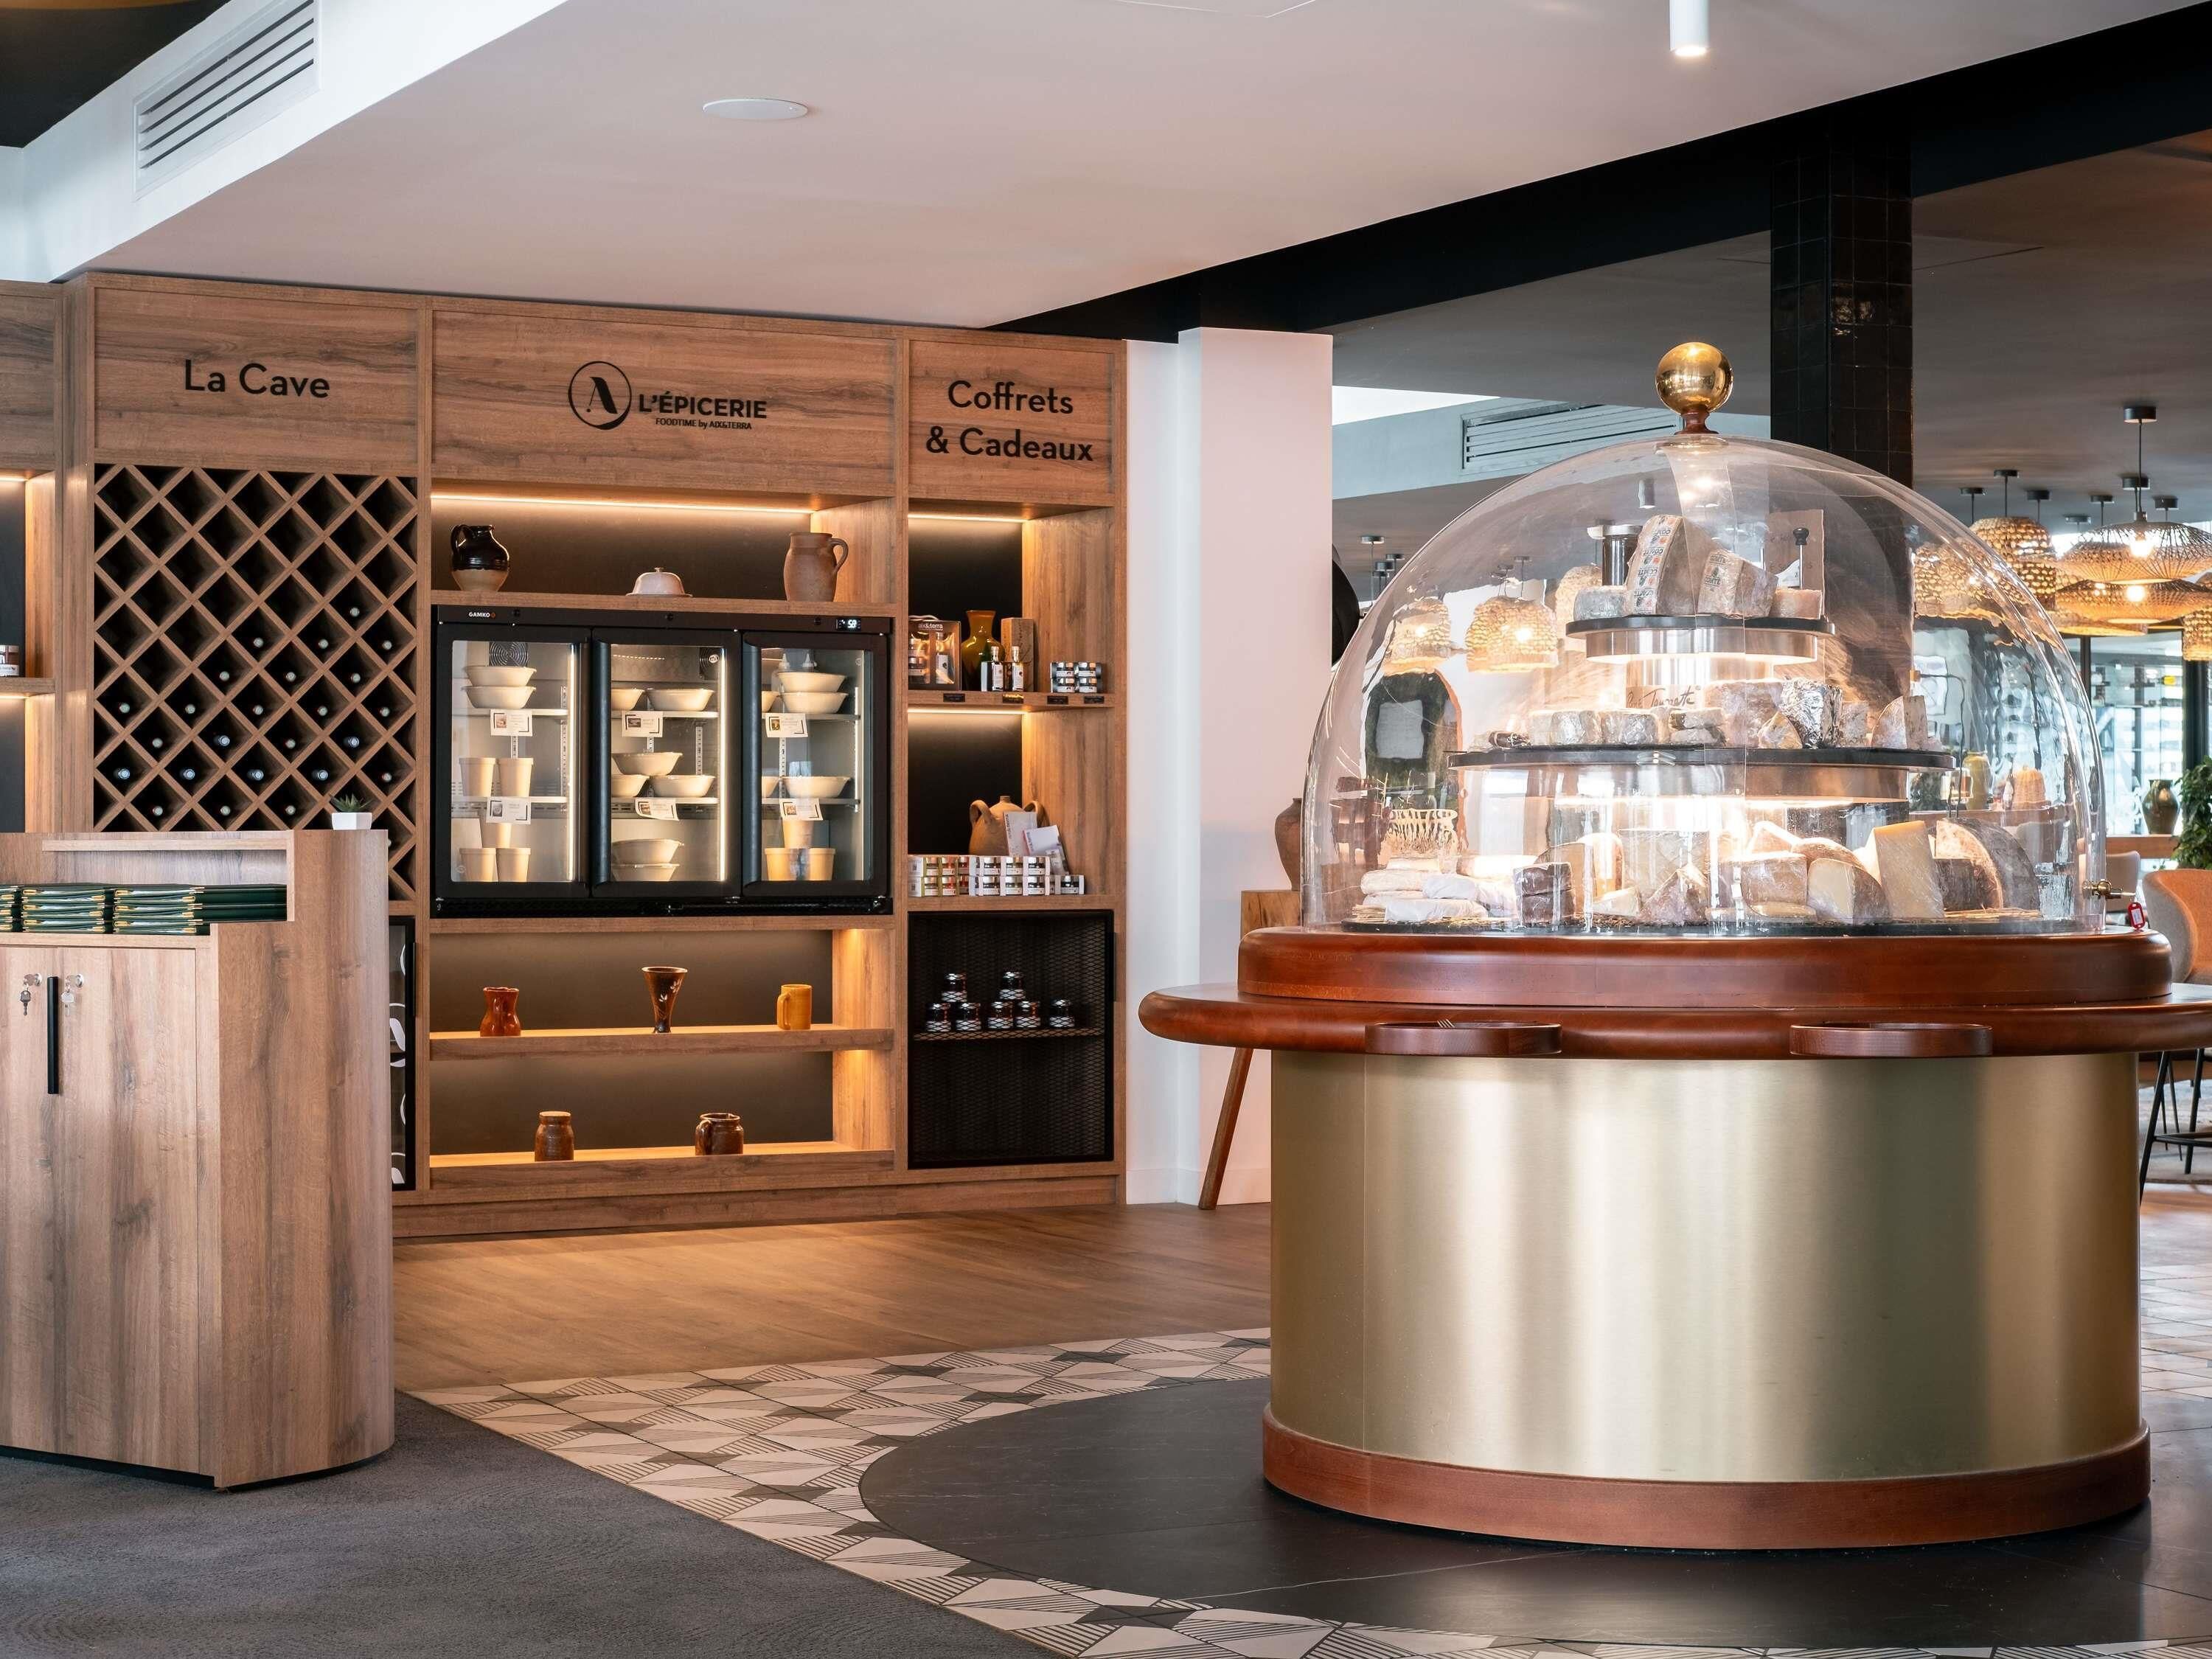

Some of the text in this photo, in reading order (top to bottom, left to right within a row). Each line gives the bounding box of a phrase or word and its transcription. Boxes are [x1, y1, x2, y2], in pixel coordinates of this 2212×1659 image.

[185, 359, 330, 398] La Cave
[947, 380, 1074, 414] Coffrets
[655, 417, 697, 427] FOODTIME
[698, 420, 708, 429] by
[925, 425, 1094, 462] & Cadeaux
